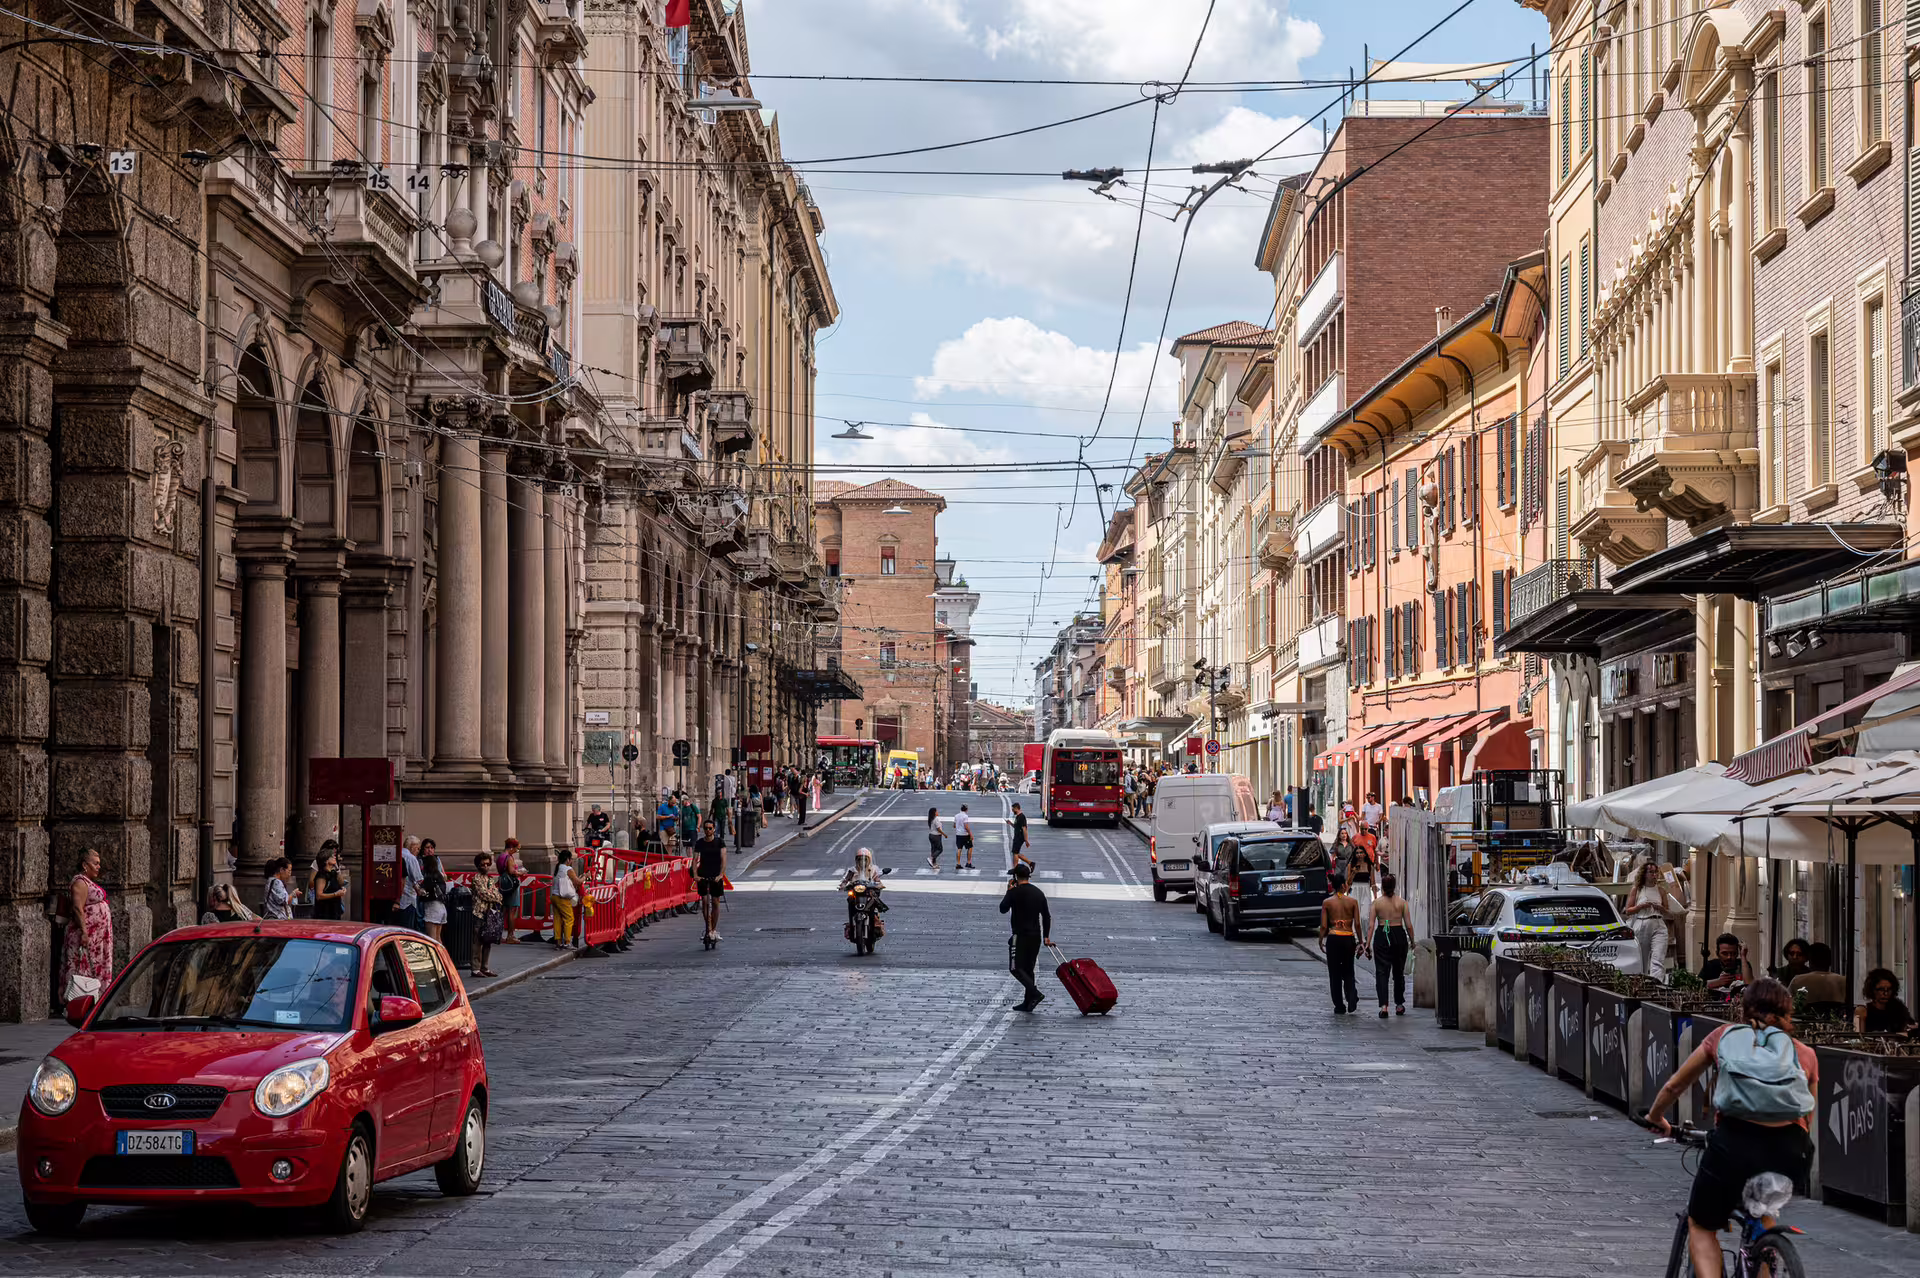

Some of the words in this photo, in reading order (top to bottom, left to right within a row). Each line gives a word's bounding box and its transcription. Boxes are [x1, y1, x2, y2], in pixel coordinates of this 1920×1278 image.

[111, 158, 133, 171] 13
[369, 174, 389, 190] 15
[407, 175, 430, 190] 14
[561, 488, 573, 497] 13
[697, 498, 709, 506] 14
[1604, 1027, 1618, 1054] DAYS
[1657, 1044, 1668, 1075] DAYS
[150, 1096, 170, 1106] KIA
[1849, 1099, 1874, 1141] DAYS
